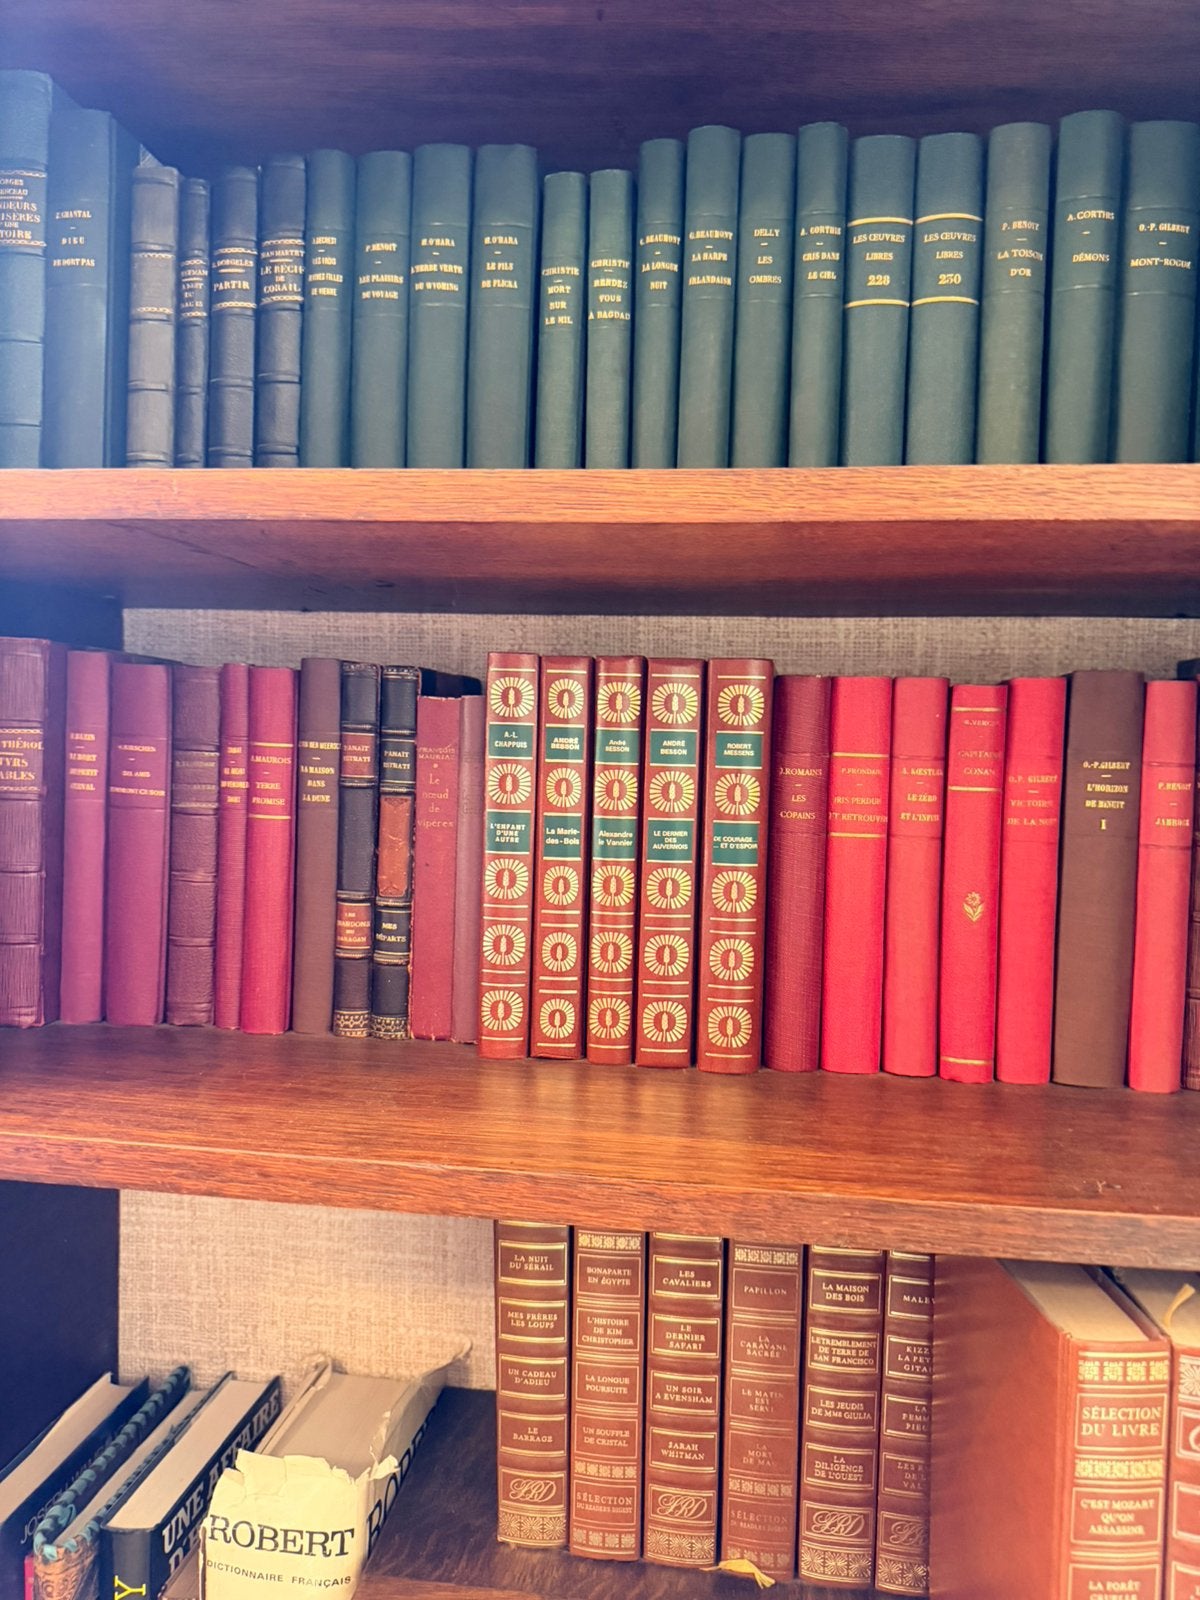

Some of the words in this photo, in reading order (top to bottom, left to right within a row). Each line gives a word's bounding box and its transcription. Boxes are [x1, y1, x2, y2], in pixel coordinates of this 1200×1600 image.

[754, 229, 780, 237] DELLY
[924, 233, 939, 242] LES
[853, 234, 867, 244] LES
[802, 252, 820, 262] CRIS
[822, 252, 840, 260] DANS
[866, 252, 893, 260] LIBRES
[936, 251, 964, 259] LIBRES
[998, 251, 1009, 260] LA
[1012, 249, 1043, 261] TOISON
[1072, 252, 1109, 262] DÉMONS
[592, 259, 630, 268] CHRISTIE
[758, 256, 773, 264] LES
[542, 266, 580, 276] CHRISTIE
[642, 263, 650, 272] LA
[652, 262, 678, 272] LONGUE
[808, 271, 818, 280] LE
[819, 271, 836, 280] CIEL
[1010, 268, 1032, 276] D'OR
[594, 279, 628, 288] RENDEZ
[749, 276, 782, 284] OMBRES
[214, 280, 250, 292] PARTIR
[264, 284, 300, 293] CORAIL
[426, 282, 459, 292] WYOMING
[548, 286, 572, 294] MORT
[650, 282, 668, 290] NUIT
[372, 290, 398, 299] VOYAGE
[599, 294, 622, 302] VOUS
[550, 301, 566, 310] SUR
[597, 311, 630, 320] BAGDAD
[545, 317, 555, 326] LE
[558, 316, 574, 324] NIL
[494, 740, 528, 748] CHAPPUIS
[309, 766, 334, 774] MAISON
[429, 774, 440, 784] Le
[306, 780, 326, 788] DANS
[1087, 784, 1128, 793] L'HORIZON
[252, 797, 285, 806] PROMISE
[429, 803, 440, 812] de
[780, 812, 816, 820] COPAINS
[524, 1262, 554, 1271] SÉRAIL
[586, 1266, 632, 1276] BONAPARTE
[600, 1276, 630, 1286] ÉGYPTE
[663, 1278, 712, 1288] CAVALIERS
[744, 1285, 787, 1295] PAPILLON
[822, 1282, 834, 1290] LA
[836, 1284, 870, 1293] MAISON
[826, 1293, 842, 1301] DES
[845, 1294, 864, 1302] BOIS
[508, 1312, 524, 1320] MES
[526, 1312, 558, 1320] FRÈRES
[528, 1320, 554, 1328] LOUPS
[587, 1316, 630, 1326] L'HISTOIRE
[582, 1336, 634, 1346] CHRISTOPHER
[666, 1332, 706, 1342] DERNIER
[669, 1342, 702, 1350] SAFARI
[740, 1340, 787, 1351] CARAVANE
[821, 1338, 876, 1348] TREMBLEMENT
[832, 1348, 856, 1356] TERRE
[832, 1356, 874, 1365] FRANCISCO
[522, 1370, 556, 1378] CADEAU
[514, 1377, 550, 1386] D'ADIEU
[598, 1375, 630, 1384] LONGUE
[586, 1384, 628, 1394] POURSUITE
[754, 1390, 784, 1398] MATIN
[664, 1394, 712, 1404] EVENSHAM
[820, 1400, 834, 1408] LES
[836, 1402, 864, 1410] JEUDIS
[1082, 1406, 1161, 1420] SÉLECTION
[583, 1426, 594, 1434] UN
[596, 1428, 630, 1437] SOUFFLE
[1082, 1423, 1105, 1436] DU
[1112, 1423, 1160, 1437] LIVRE
[513, 1433, 553, 1442] BARRAGE
[596, 1438, 628, 1447] CRISTAL
[668, 1442, 698, 1450] SARAH
[661, 1449, 705, 1460] WHITMAN
[834, 1456, 845, 1464] LA
[814, 1461, 864, 1472] DILIGENCE
[814, 1469, 826, 1478] DE
[828, 1472, 862, 1482] L'OUEST
[576, 1492, 633, 1506] SÉLECTION
[1080, 1498, 1110, 1510] C'EST
[1112, 1499, 1154, 1511] MOZART
[162, 1482, 204, 1554] UNE
[1101, 1512, 1135, 1524] QU'ON
[1088, 1525, 1144, 1536] ASSASSINE
[208, 1514, 354, 1558] ROBERT
[206, 1560, 284, 1582] DICTIONNAIRE
[292, 1576, 351, 1588] FRANÇAIS
[1088, 1580, 1103, 1590] LA
[1106, 1579, 1140, 1591] FORÊT
